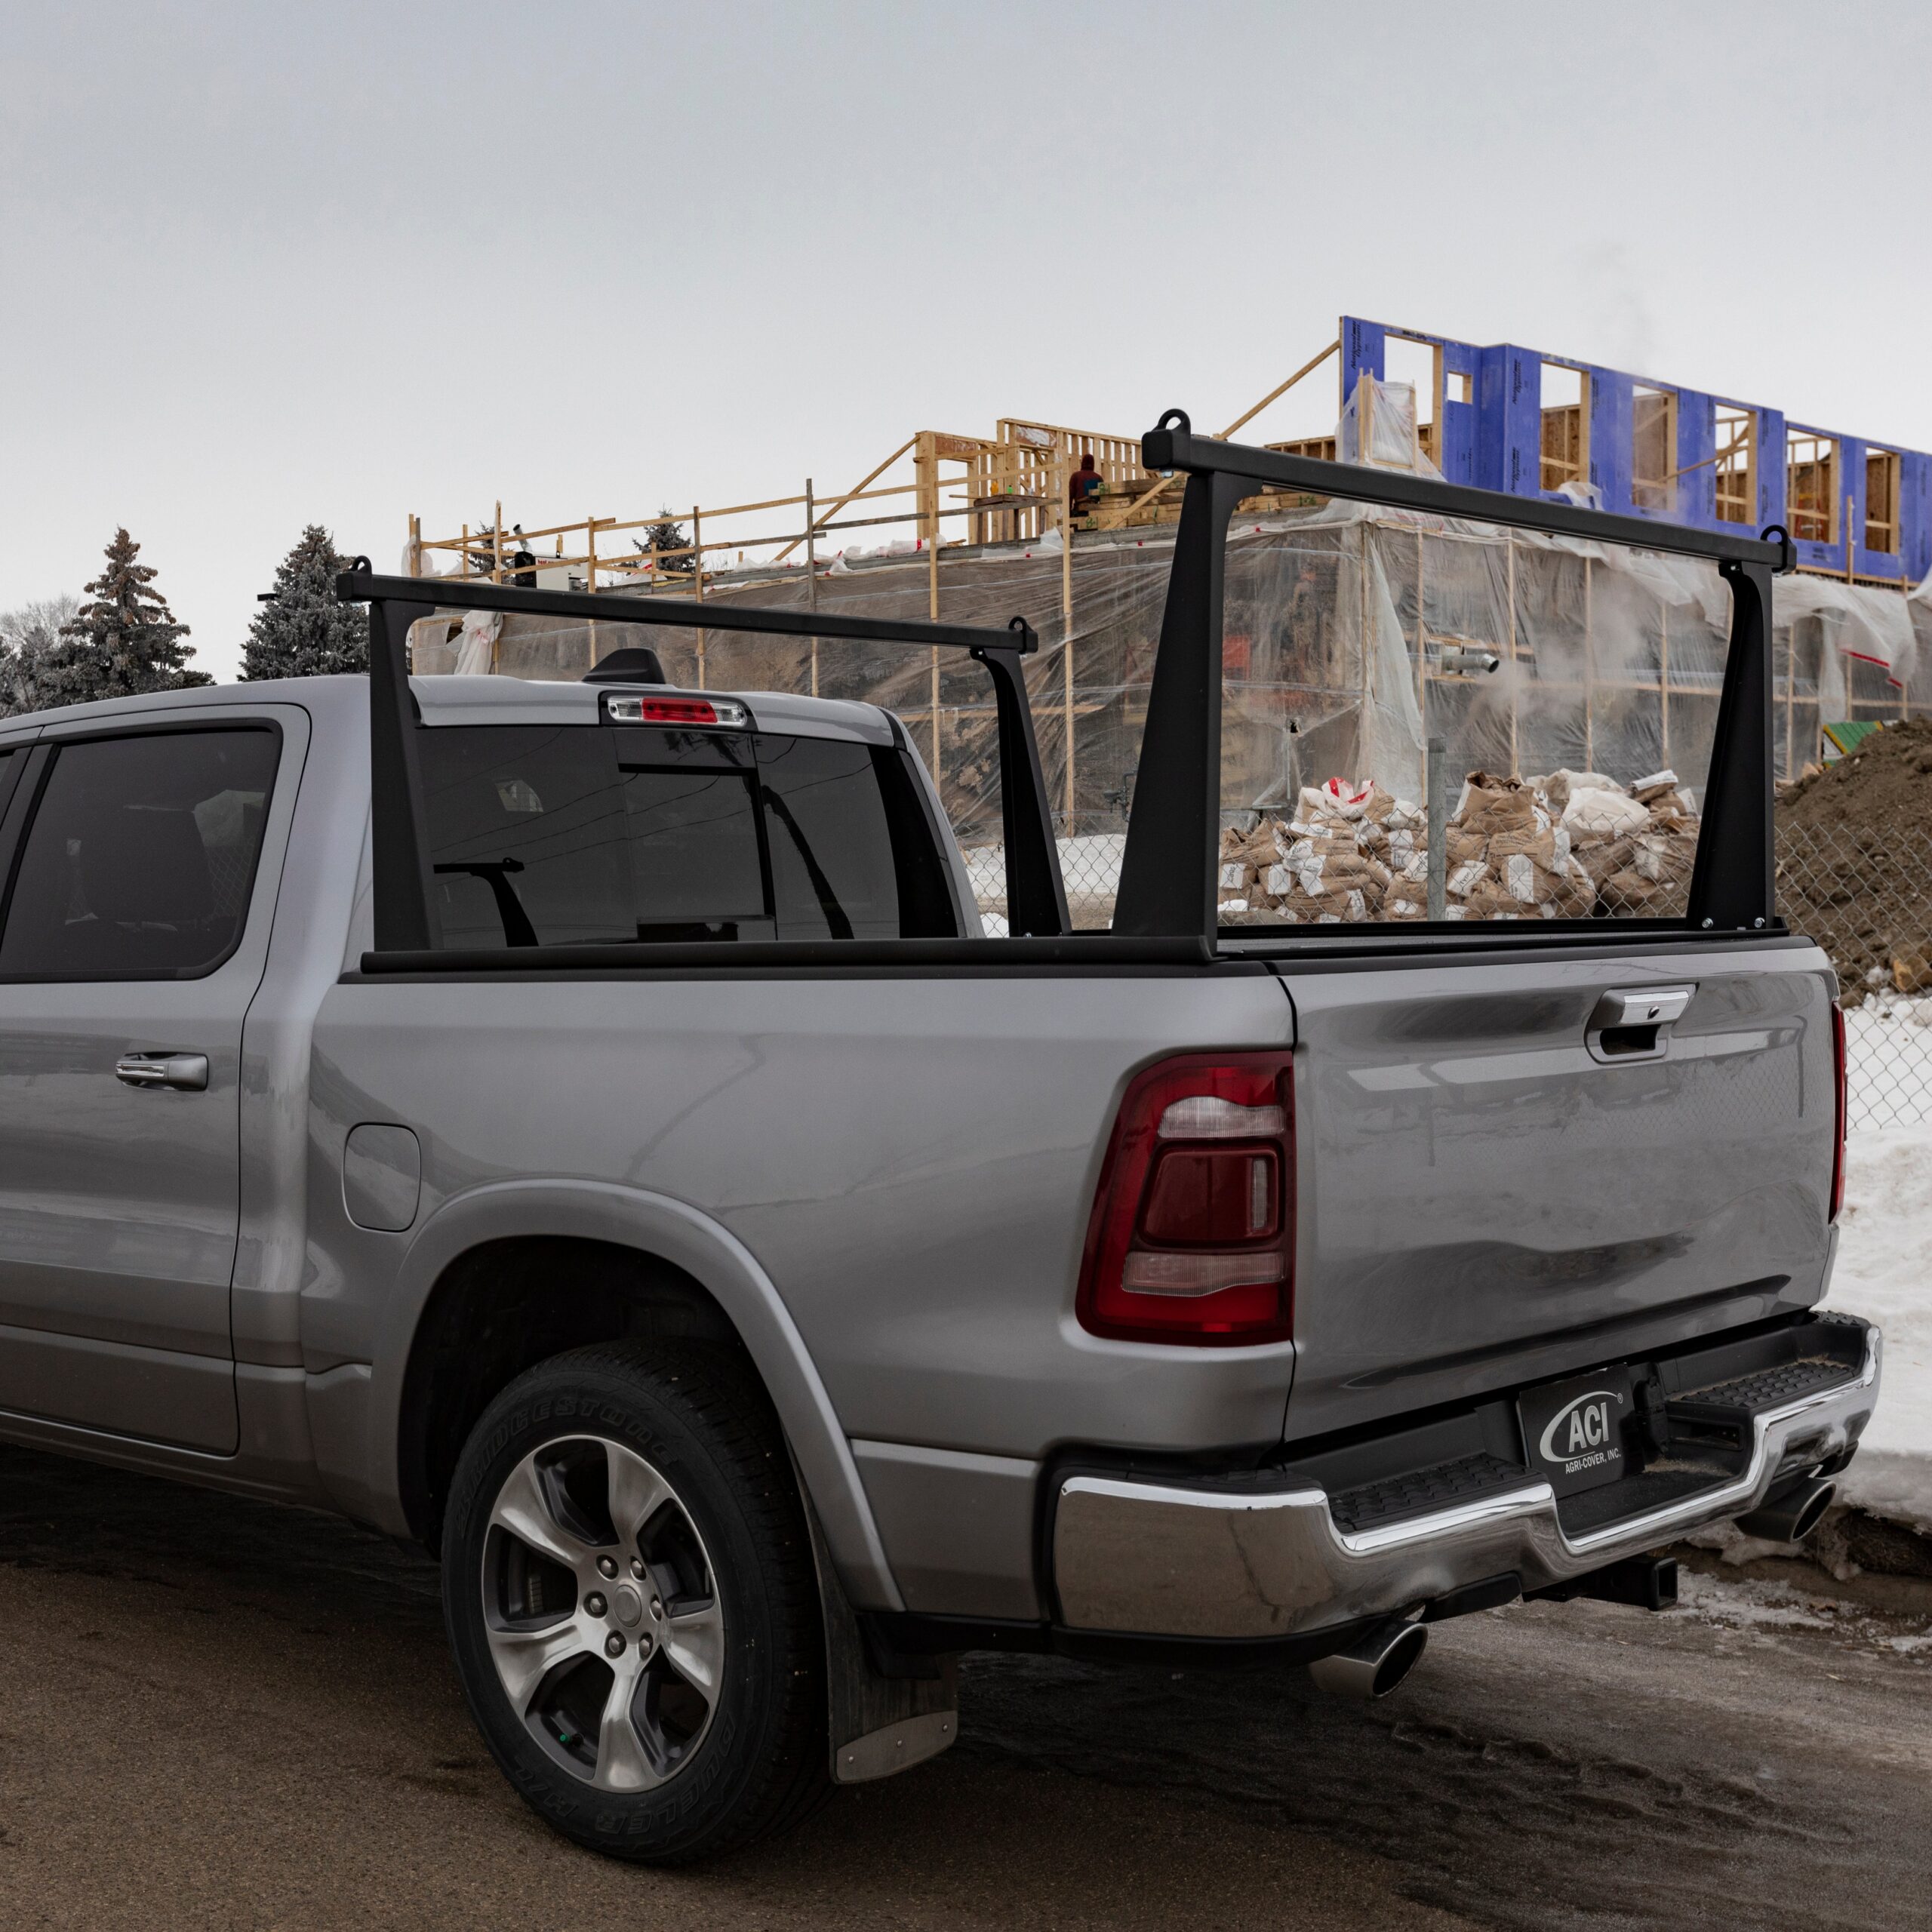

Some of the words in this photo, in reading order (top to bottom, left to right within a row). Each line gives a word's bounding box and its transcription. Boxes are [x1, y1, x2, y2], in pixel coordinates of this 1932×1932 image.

[1568, 1401, 1609, 1453] ACI
[1565, 1454, 1607, 1475] AGRI-COVER,
[1607, 1447, 1622, 1462] INC.
[595, 1711, 737, 1835] DUELER
